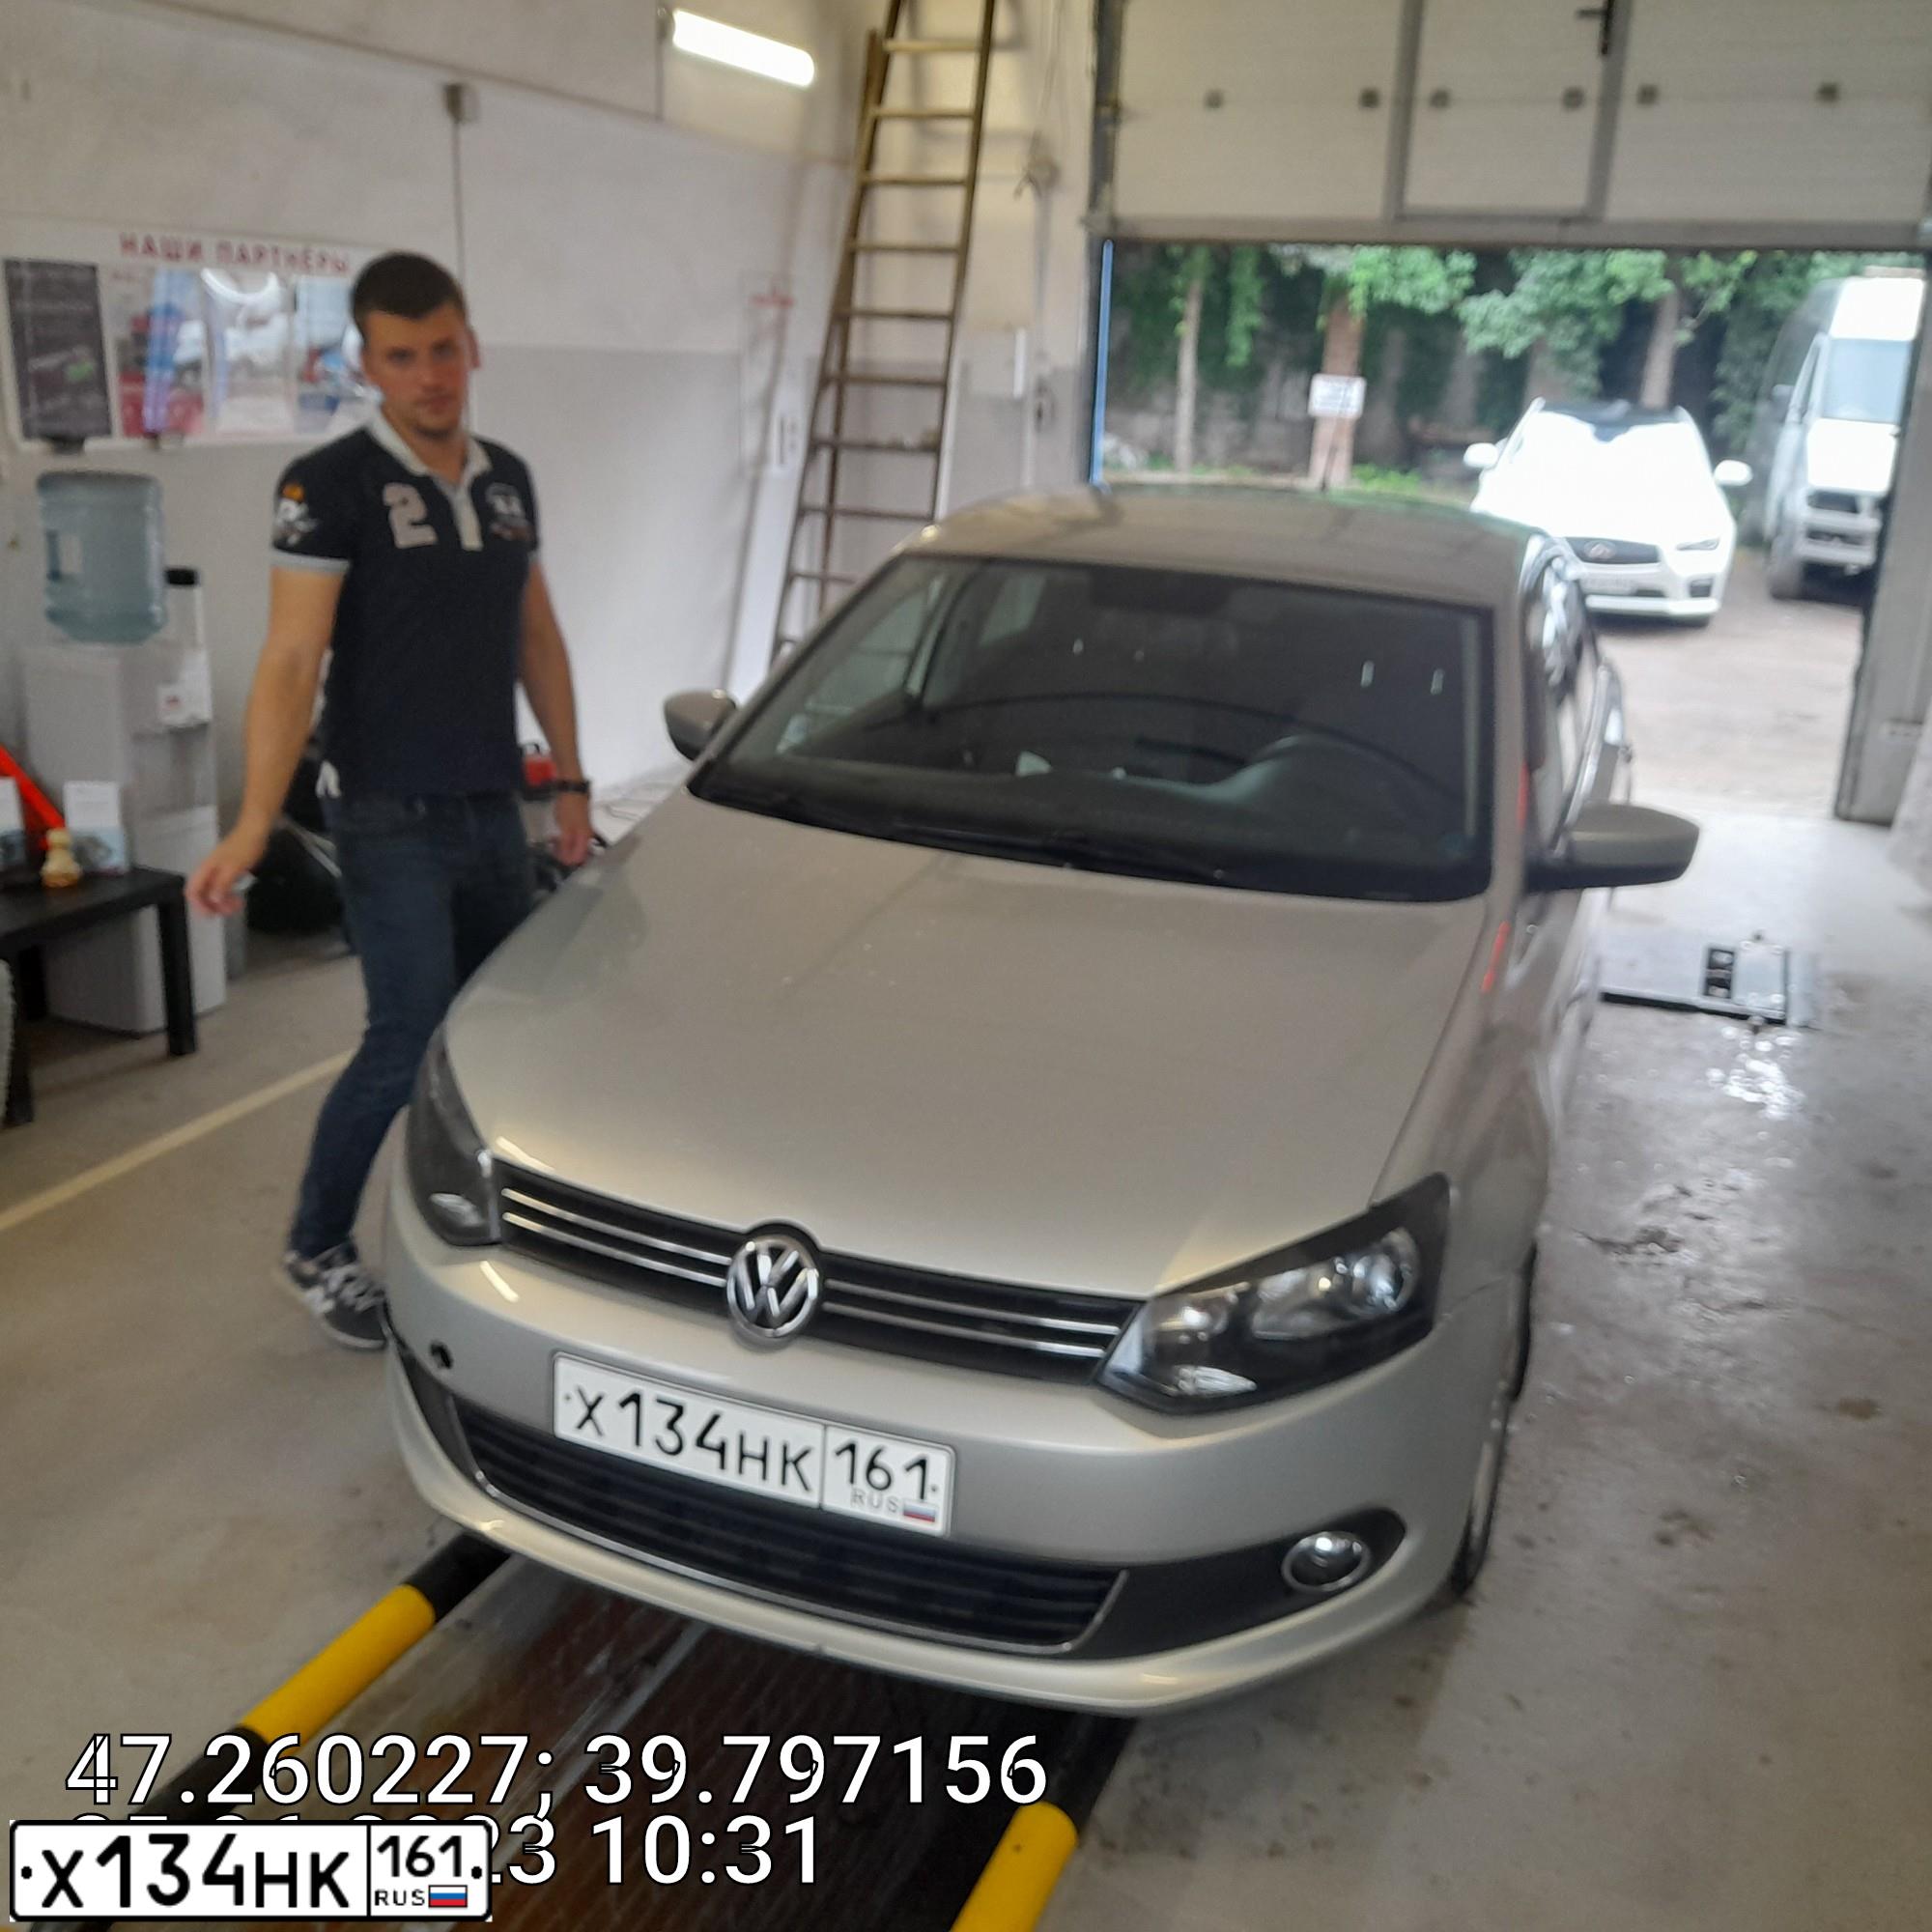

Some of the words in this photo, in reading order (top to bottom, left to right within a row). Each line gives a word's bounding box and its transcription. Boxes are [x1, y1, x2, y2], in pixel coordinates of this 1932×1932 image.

[119, 232, 202, 262] НАШИ
[383, 483, 438, 549] 2
[836, 1442, 927, 1500] 161
[852, 1489, 899, 1514] RUS
